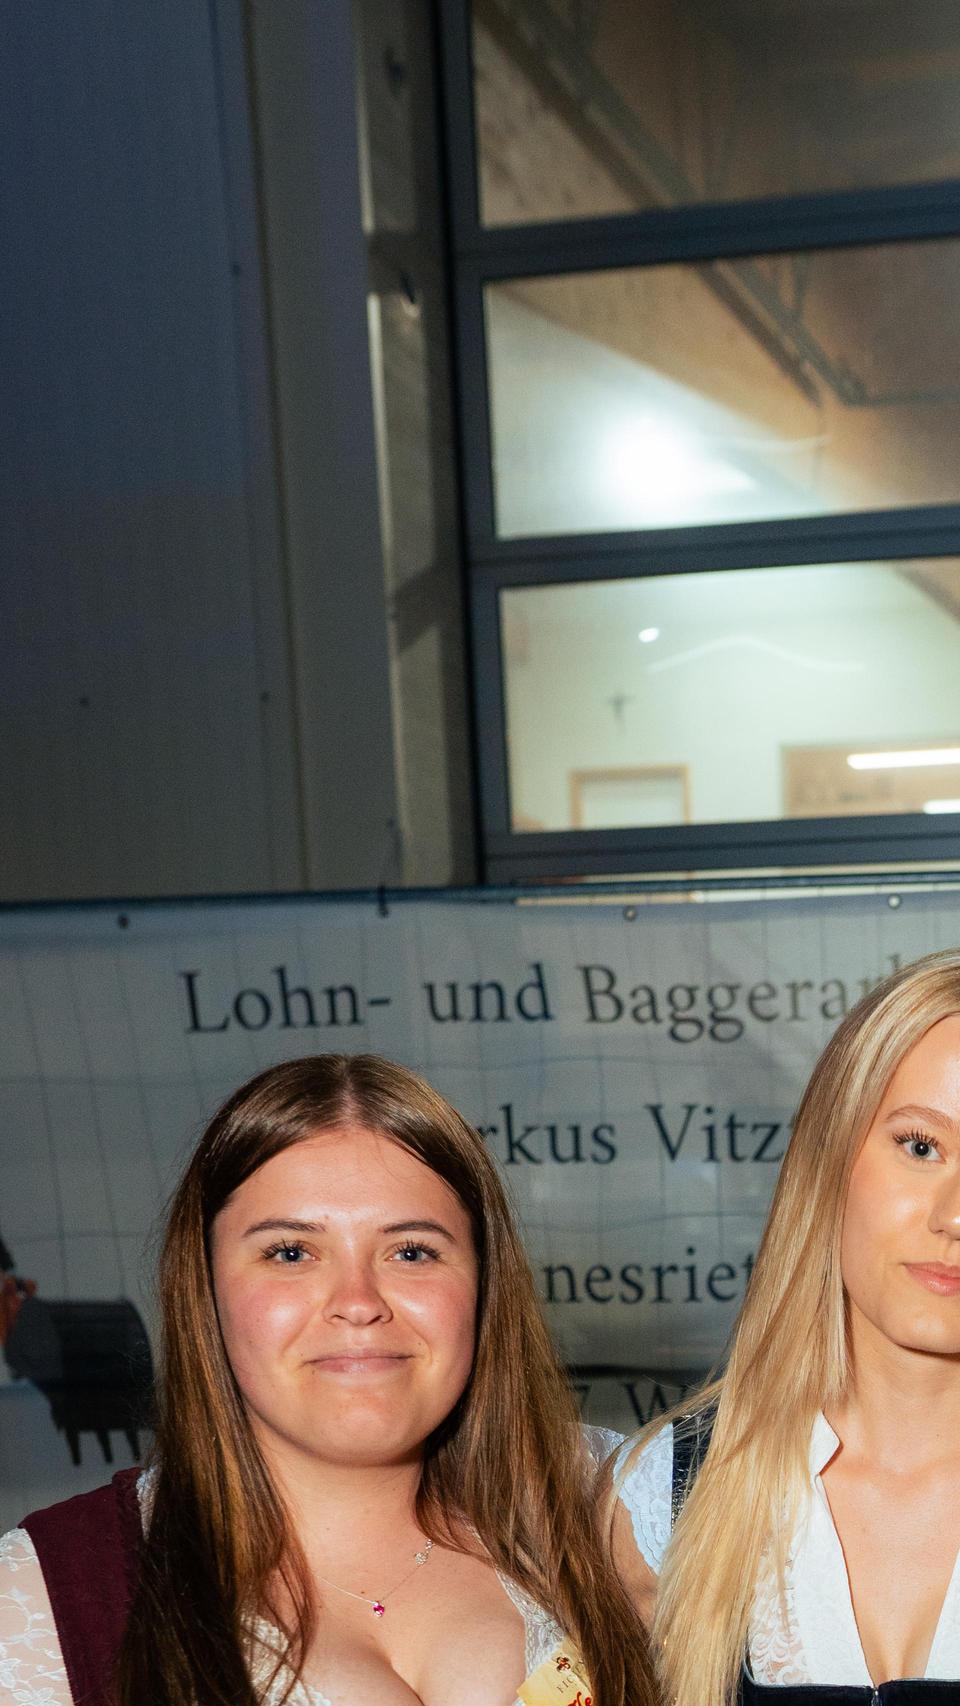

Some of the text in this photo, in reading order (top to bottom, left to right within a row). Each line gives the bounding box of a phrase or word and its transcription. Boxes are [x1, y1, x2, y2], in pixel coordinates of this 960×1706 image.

[180, 964, 391, 1034] Lohn-
[424, 961, 556, 1027] und
[647, 1103, 790, 1167] Vitz
